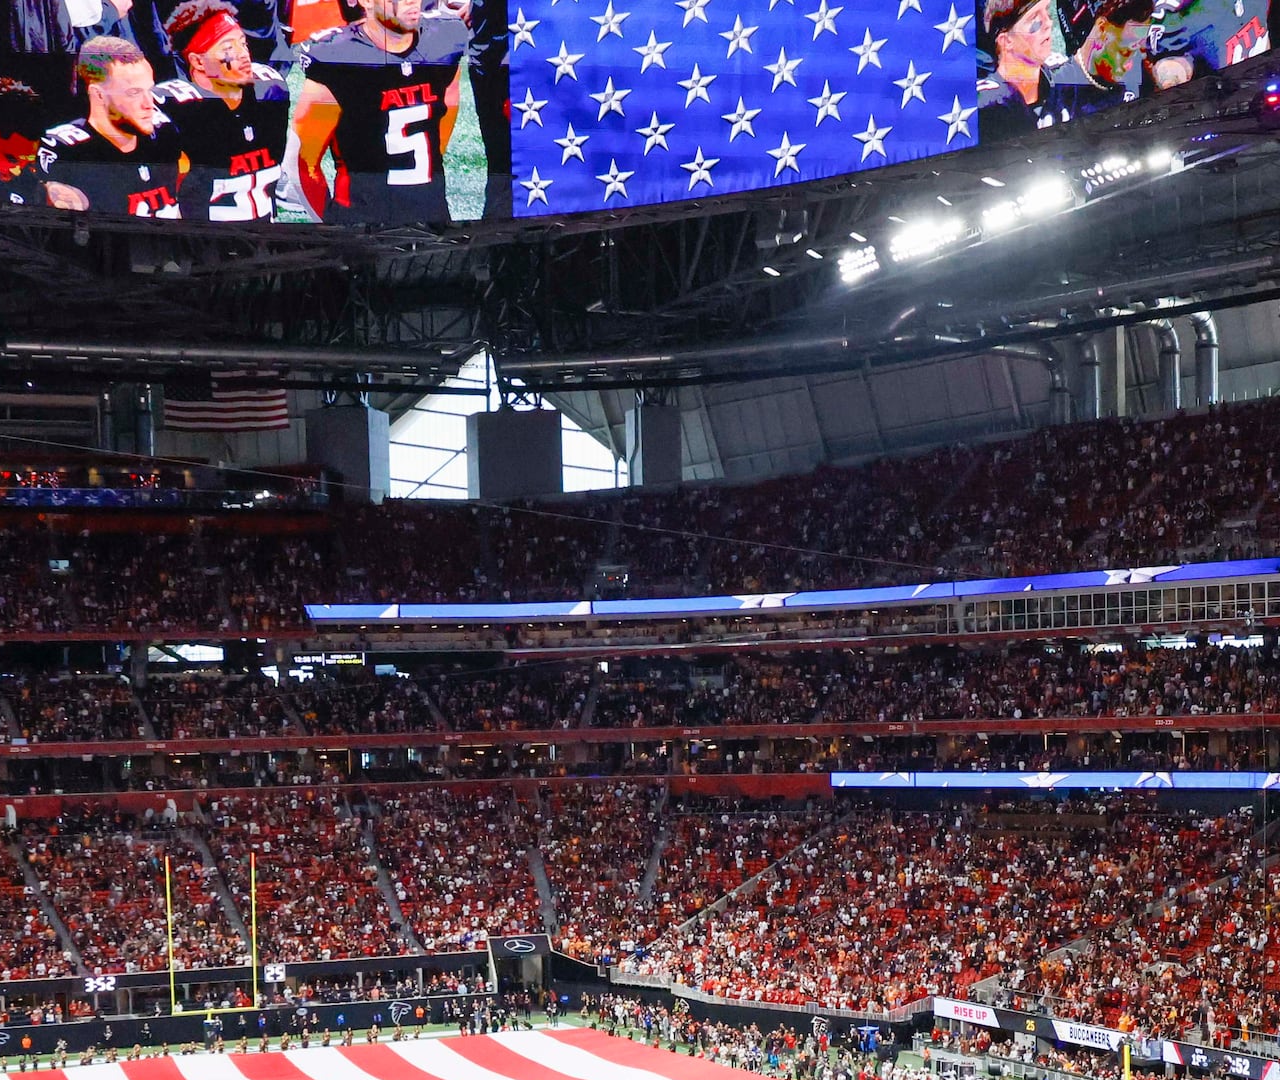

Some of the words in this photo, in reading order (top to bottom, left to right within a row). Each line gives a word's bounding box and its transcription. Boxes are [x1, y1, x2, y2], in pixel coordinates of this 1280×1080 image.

[1226, 16, 1268, 65] ATL
[380, 83, 438, 111] ATL
[385, 104, 432, 185] 5
[229, 148, 277, 176] ATL
[128, 186, 175, 215] ATL
[266, 966, 285, 981] 25
[85, 977, 116, 993] 3:52
[954, 1006, 974, 1018] RISE
[976, 1009, 988, 1021] UP
[1025, 1020, 1036, 1031] 25
[1069, 1027, 1111, 1047] BUCCANEERS
[1225, 1054, 1251, 1075] :52
